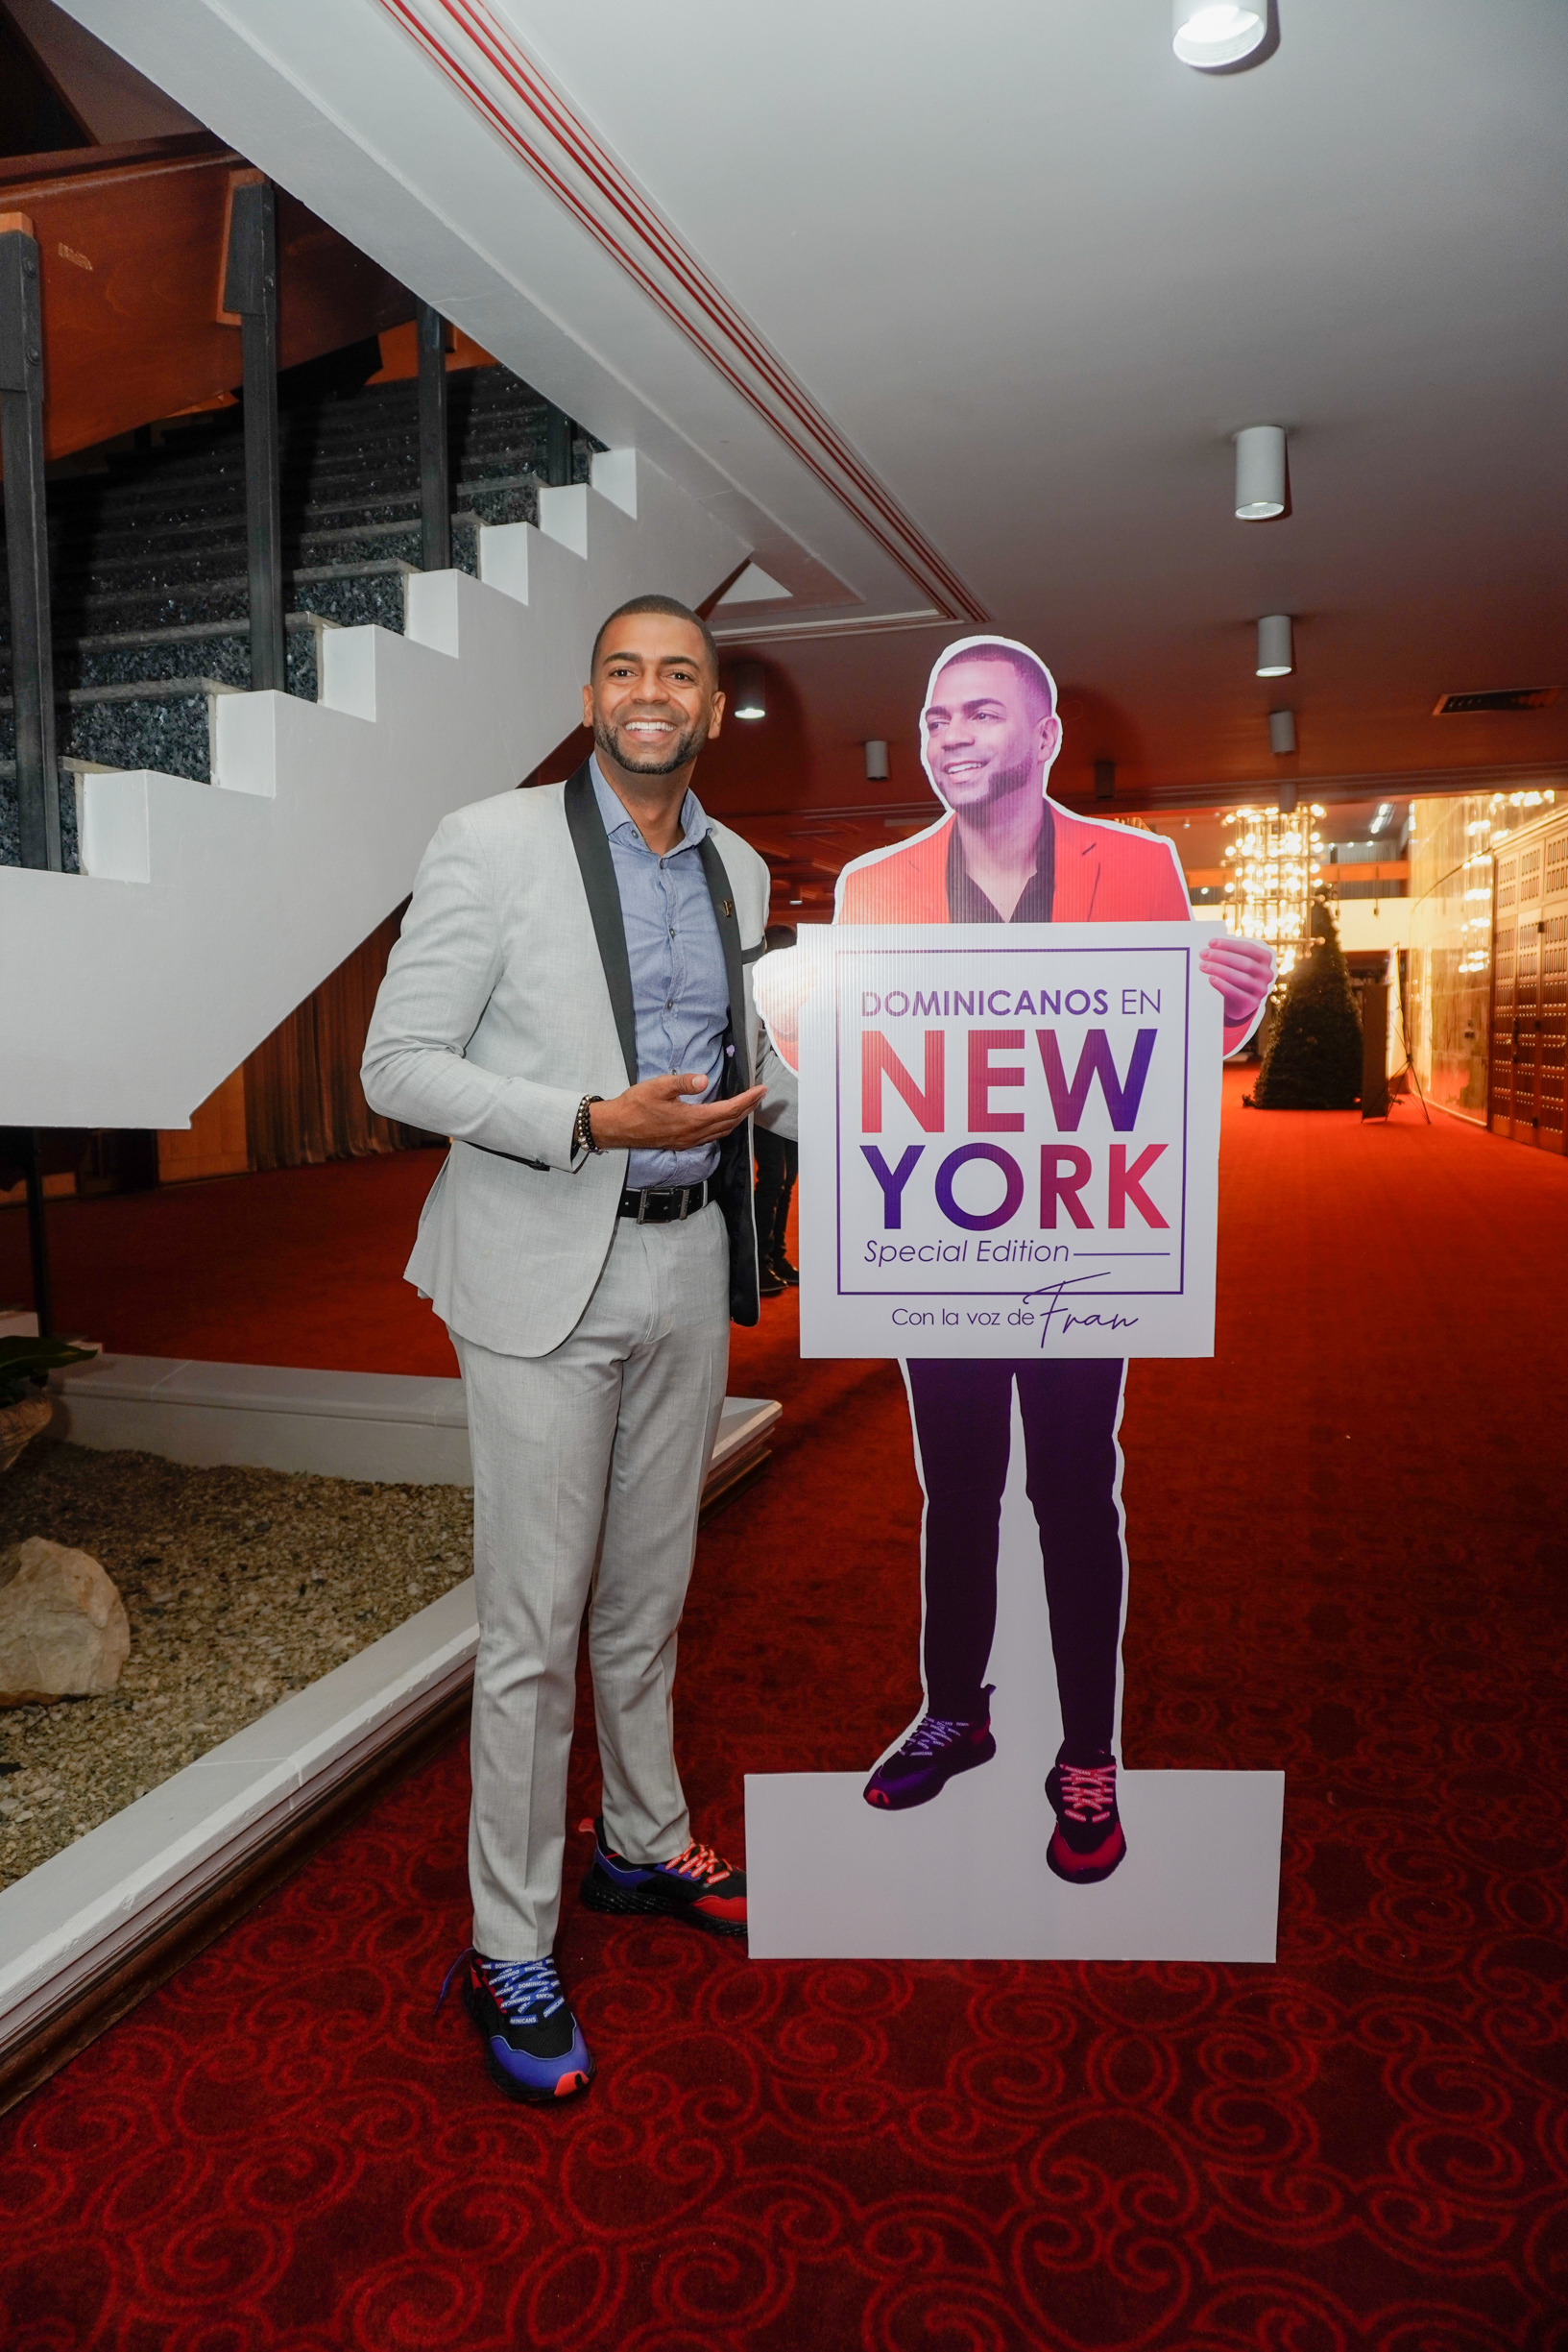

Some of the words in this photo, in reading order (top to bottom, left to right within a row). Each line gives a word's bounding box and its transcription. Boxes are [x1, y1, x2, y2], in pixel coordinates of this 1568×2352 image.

[861, 989, 1109, 1017] DOMINICANOS
[1122, 989, 1161, 1015] EN
[861, 1028, 1158, 1133] NEW
[859, 1142, 1170, 1231] YORK
[864, 1240, 968, 1268] Special
[977, 1240, 1069, 1263] Edition
[891, 1308, 934, 1325] Con
[942, 1308, 959, 1325] la
[967, 1313, 1001, 1325] voz
[1007, 1308, 1035, 1325] de
[1023, 1272, 1139, 1348] Fran
